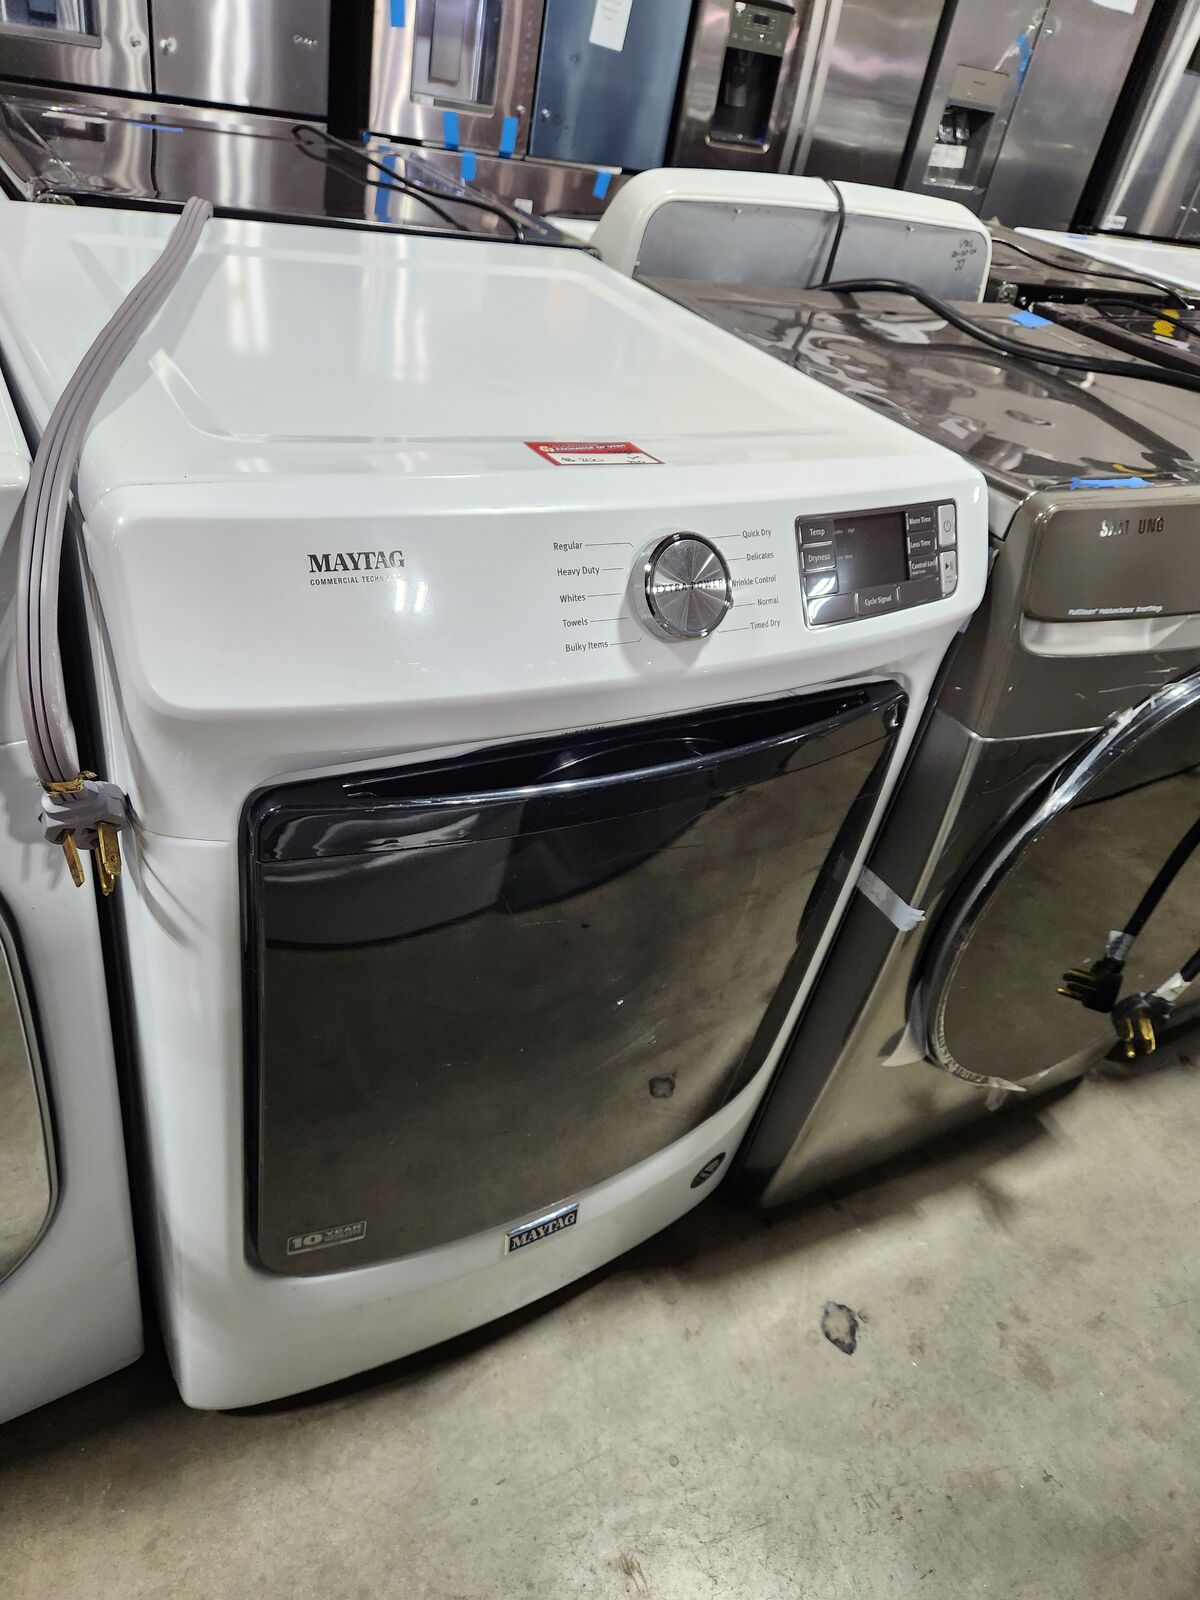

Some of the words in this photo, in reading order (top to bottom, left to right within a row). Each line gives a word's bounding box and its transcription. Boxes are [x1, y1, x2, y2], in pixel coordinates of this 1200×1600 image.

[921, 515, 932, 523] Time
[742, 529, 760, 539] Quick
[760, 528, 772, 537] Dry
[810, 528, 826, 537] Temp
[553, 541, 583, 552] Regular
[910, 541, 920, 549] Less
[307, 550, 405, 573] MAYTAG
[746, 552, 774, 561] Delicates
[807, 553, 831, 563] Dryness
[911, 560, 927, 570] Control
[557, 568, 581, 577] Heavy
[582, 566, 600, 576] Duty
[310, 577, 360, 586] COMMERCIAL
[754, 574, 777, 584] Control
[559, 593, 586, 603] Whites
[757, 596, 779, 606] Normal
[864, 597, 878, 607] Cycle
[878, 594, 892, 604] Signal
[562, 617, 589, 627] Towels
[750, 620, 769, 629] Timed
[770, 618, 781, 627] Dry
[565, 642, 587, 653] Bulky
[588, 641, 609, 650] Items
[511, 1212, 577, 1250] MAYTAG
[291, 1234, 323, 1249] 10
